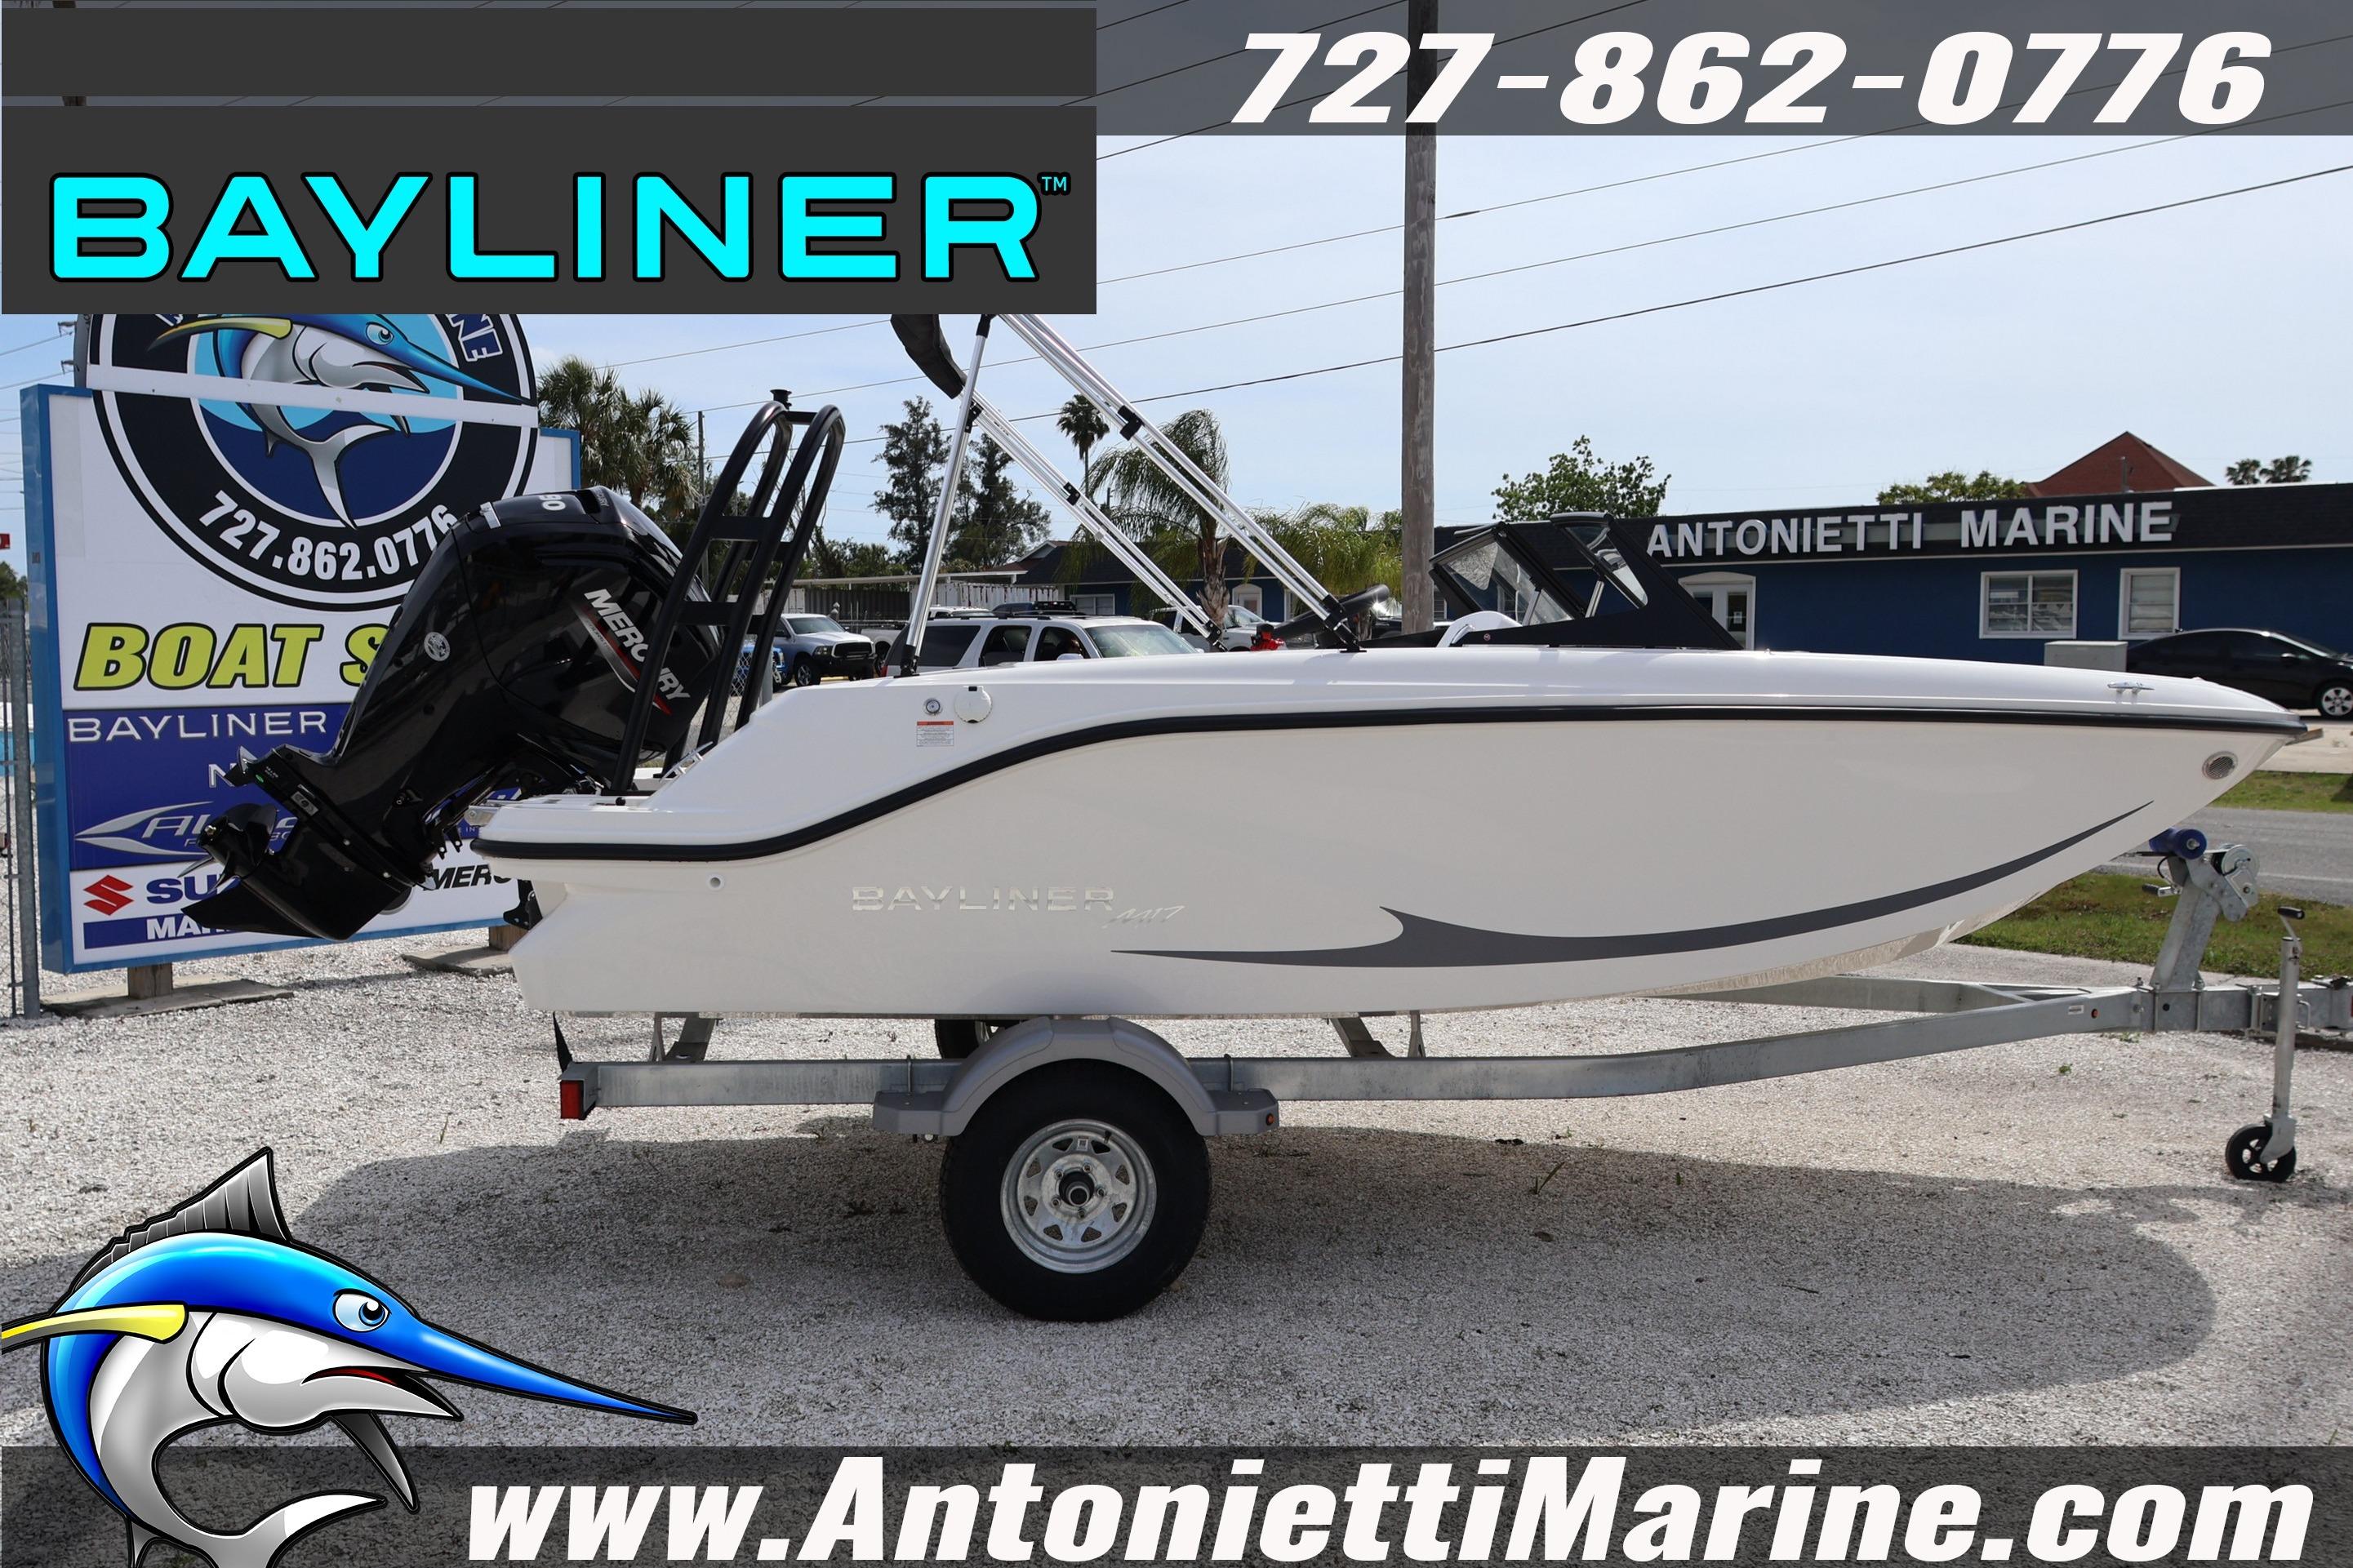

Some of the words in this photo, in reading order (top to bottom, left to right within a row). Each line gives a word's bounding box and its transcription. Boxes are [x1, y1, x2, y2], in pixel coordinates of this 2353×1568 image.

[198, 490, 459, 580] 727.862.0776
[1647, 512, 1924, 558] ANTONIETTI
[1961, 500, 2174, 548] MARINE
[73, 623, 324, 691] BOAT
[584, 588, 691, 700] MERCRY
[68, 709, 327, 744] BAYLINER
[852, 886, 1115, 912] BAYLINER
